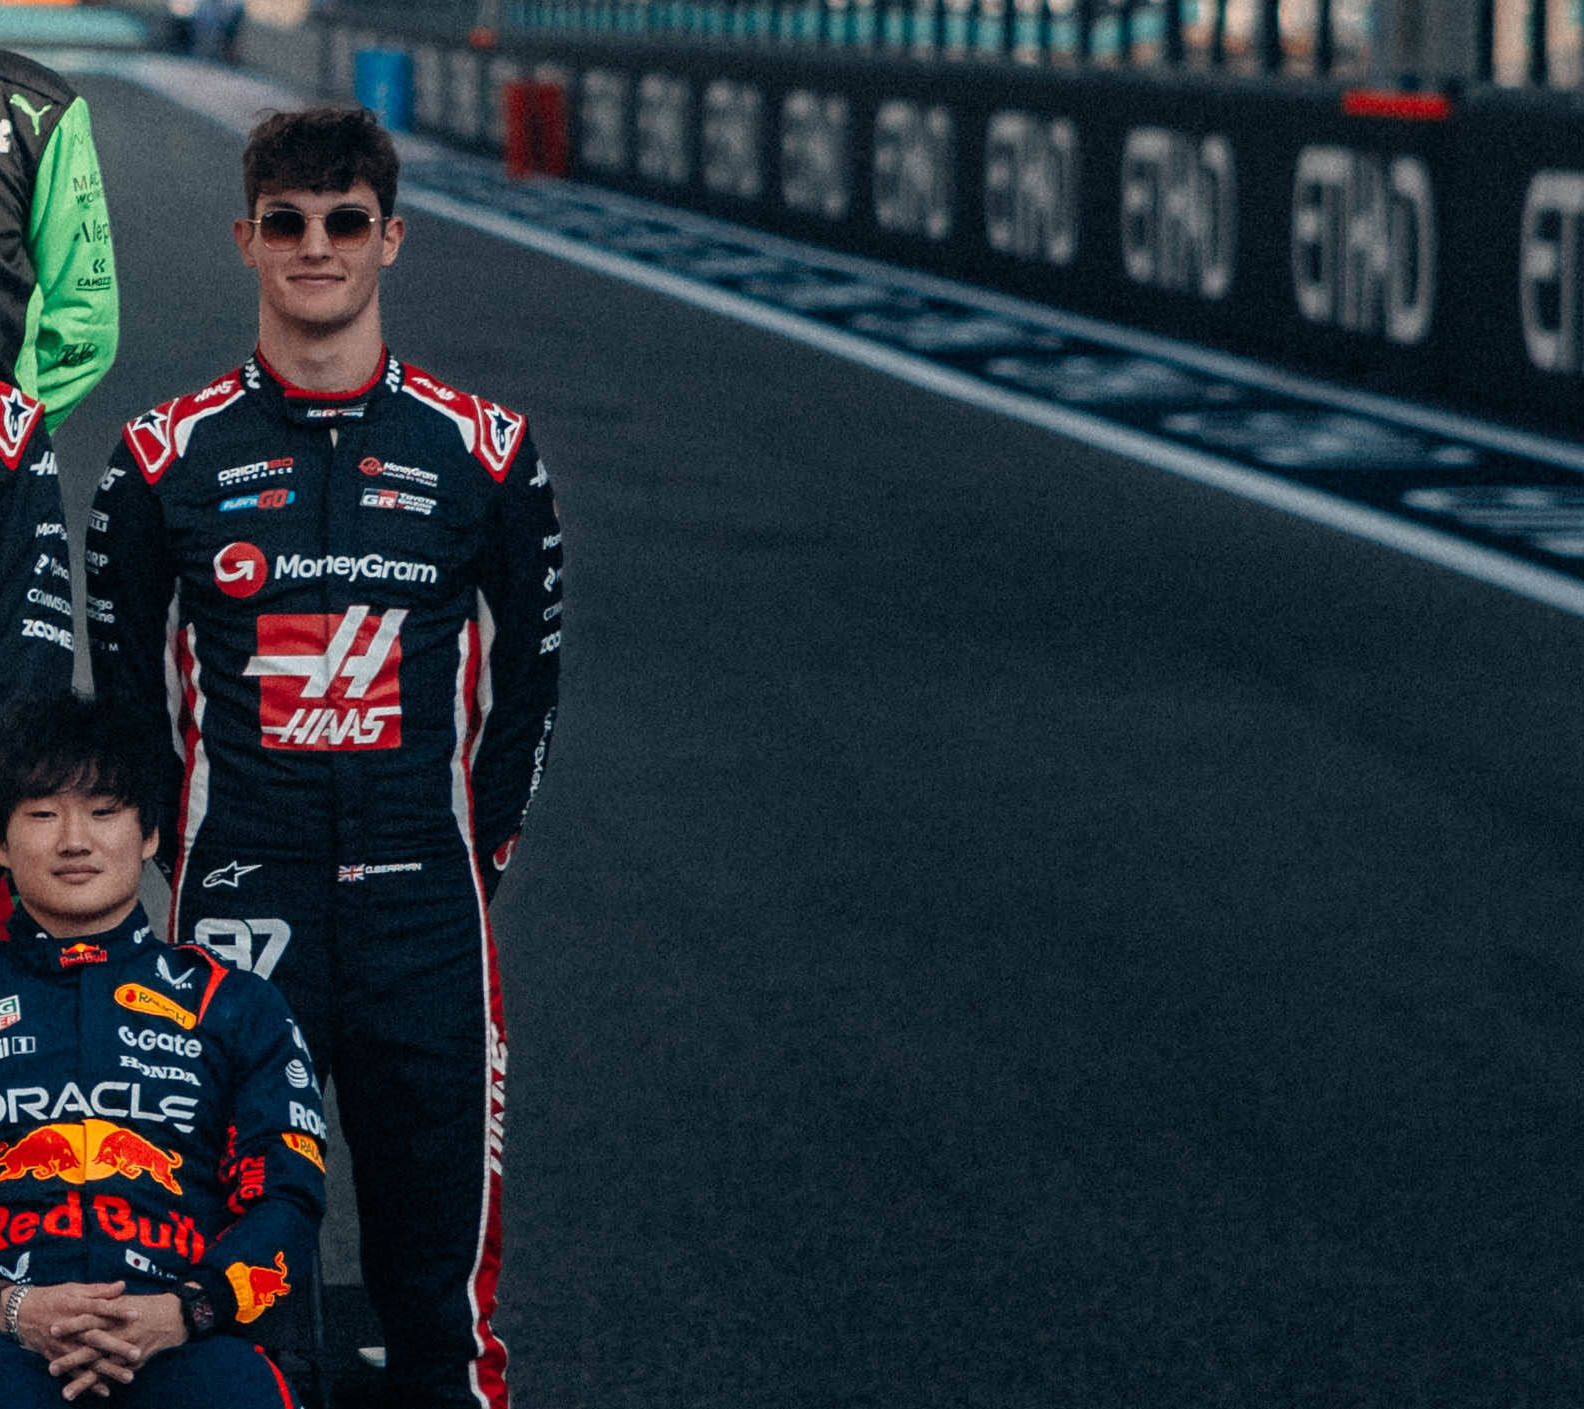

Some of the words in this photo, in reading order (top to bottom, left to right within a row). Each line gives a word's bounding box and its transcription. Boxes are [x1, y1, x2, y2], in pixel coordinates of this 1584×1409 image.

[1121, 127, 1236, 299] ETIHAD
[1290, 145, 1437, 345] ETIHAD
[384, 462, 437, 480] MoneyGram
[275, 554, 436, 584] MoneyGram
[262, 706, 401, 744] HAAS
[61, 952, 83, 967] Red
[84, 952, 107, 967] Bull
[140, 1033, 202, 1058] Gate
[120, 1055, 201, 1087] HONDA
[96, 1195, 205, 1264] Bull
